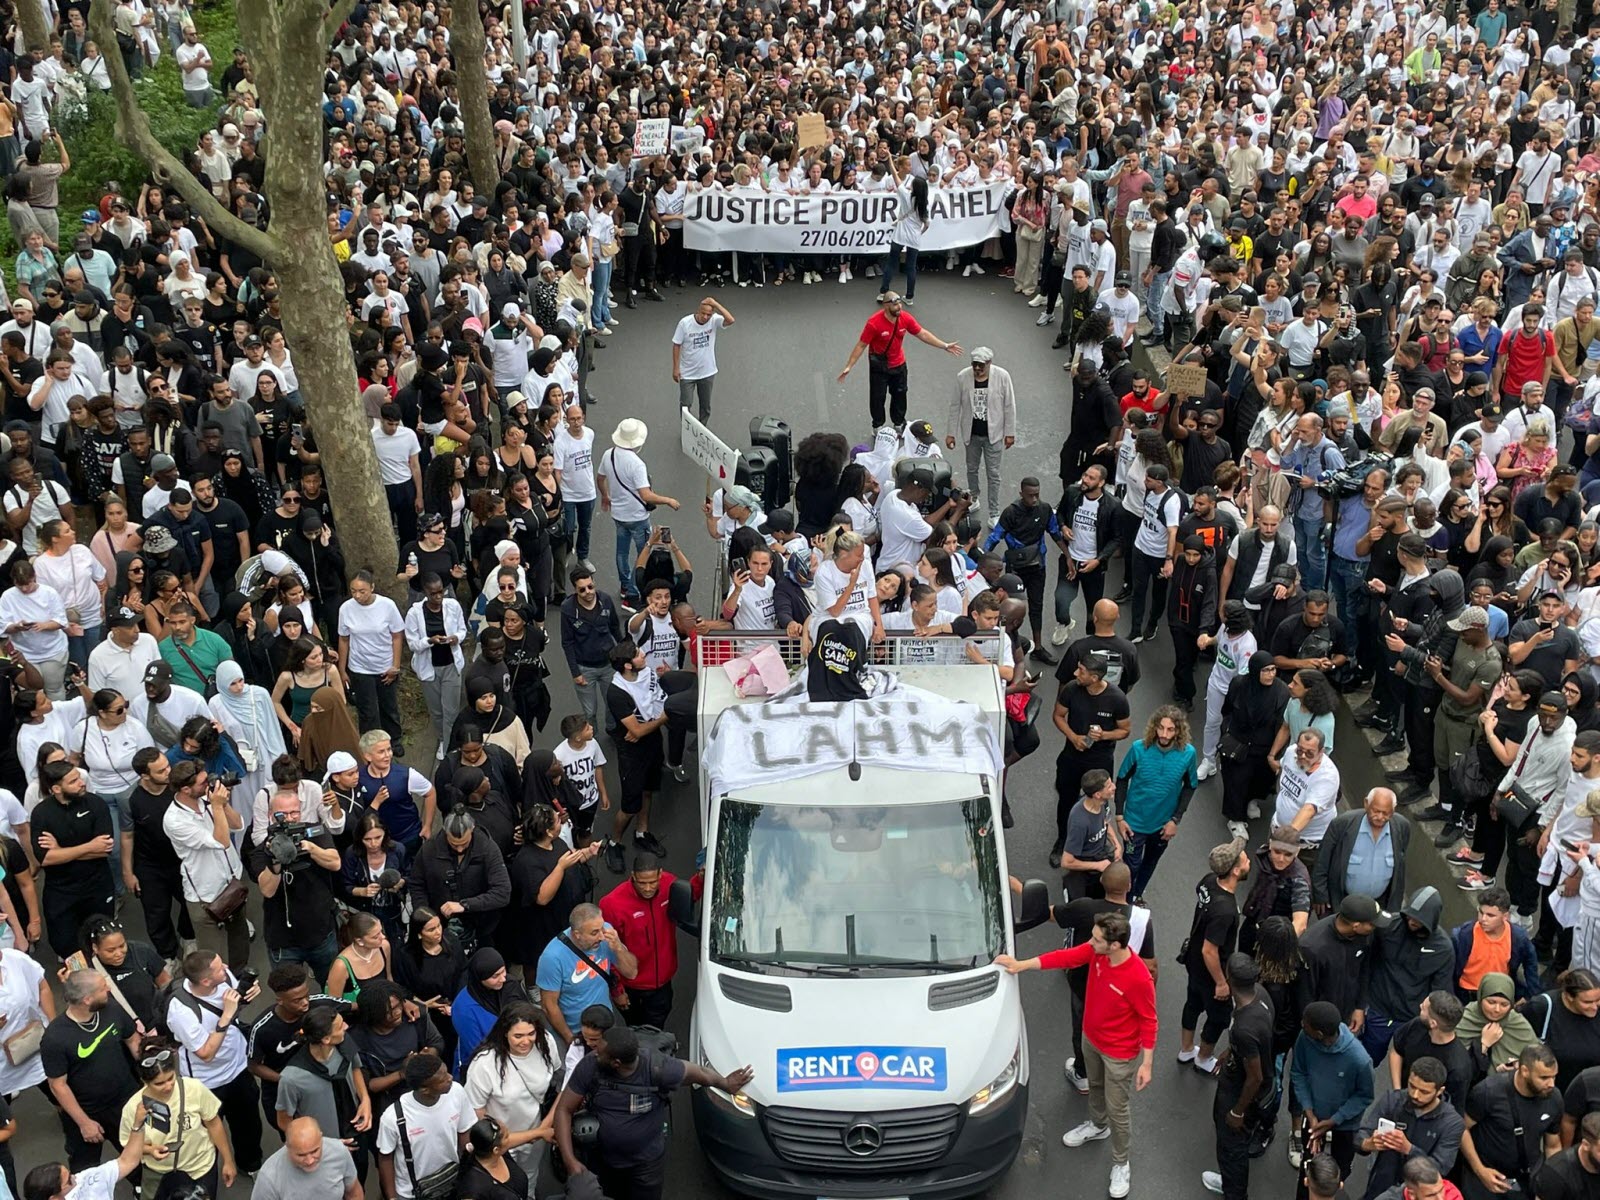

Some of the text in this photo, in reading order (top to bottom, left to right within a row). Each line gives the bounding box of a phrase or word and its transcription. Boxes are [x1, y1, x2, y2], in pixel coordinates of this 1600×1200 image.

[687, 196, 810, 225] JUSTICE
[821, 198, 898, 224] POUR
[928, 189, 998, 219] AHEL
[685, 419, 727, 466] JUSTICE
[655, 641, 675, 650] NAHEL
[788, 1054, 935, 1079] RENT a CAR
